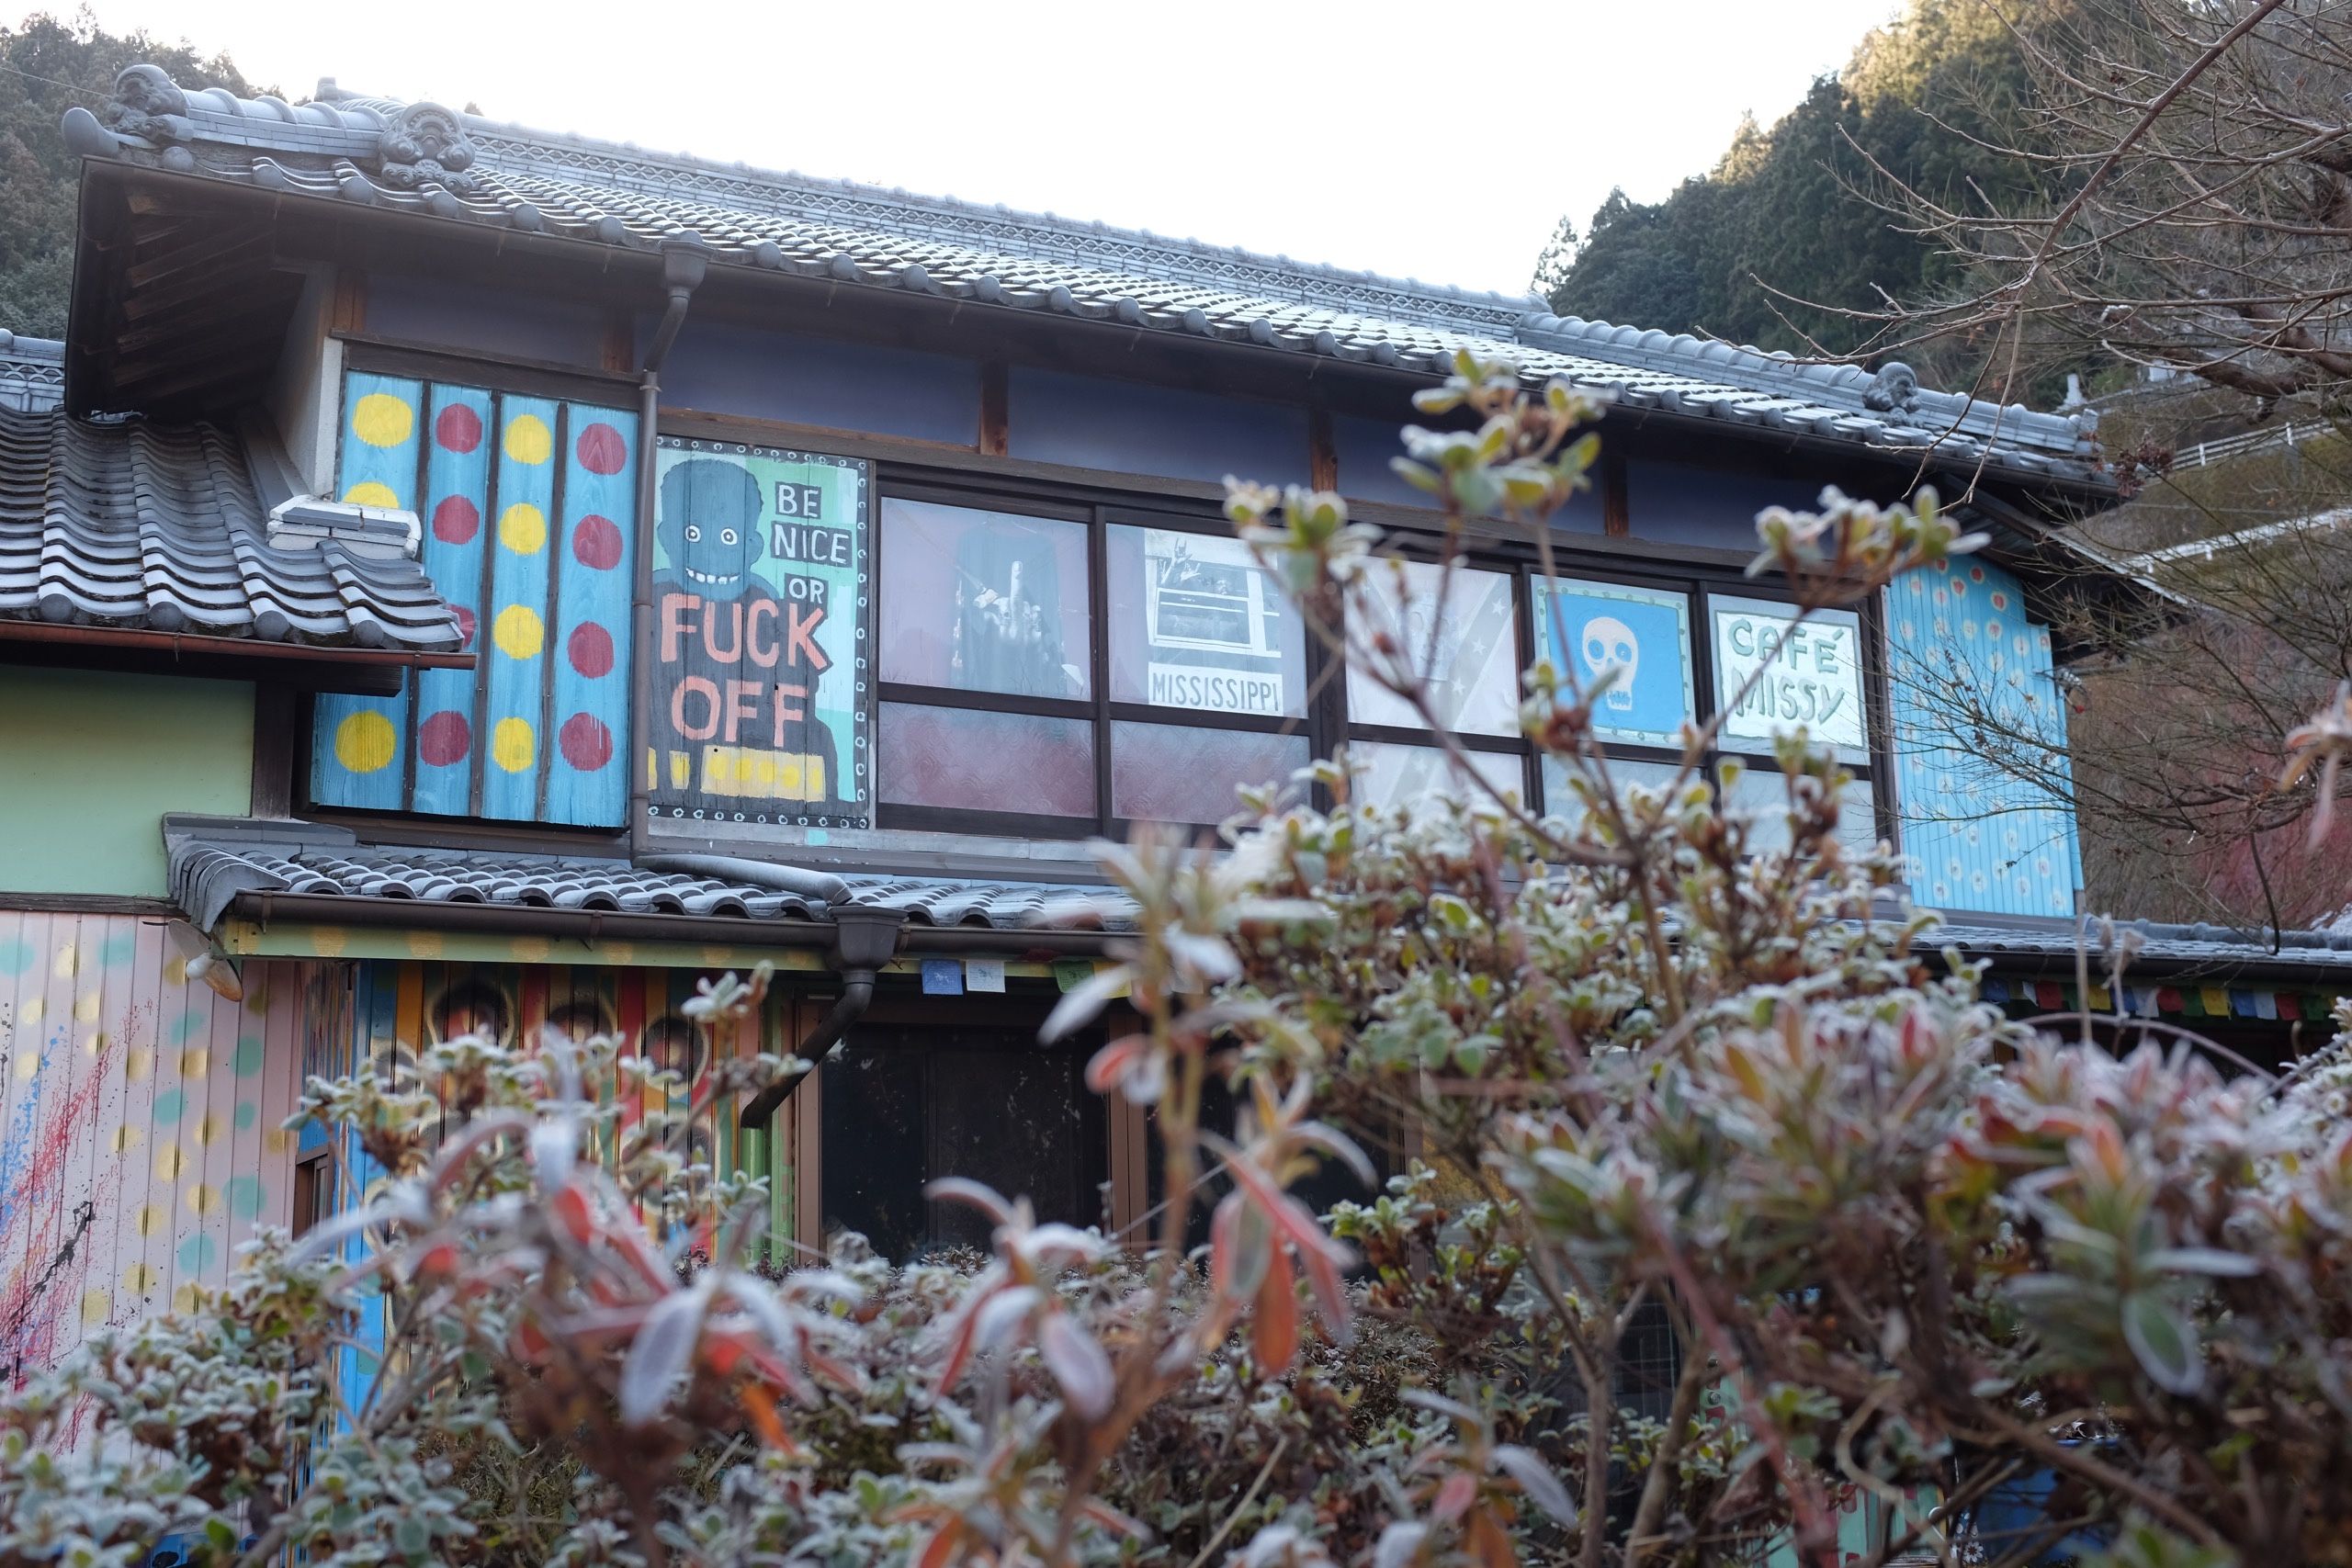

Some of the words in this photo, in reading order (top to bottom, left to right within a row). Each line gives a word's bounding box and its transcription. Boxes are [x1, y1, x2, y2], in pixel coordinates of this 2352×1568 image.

[778, 485, 820, 517] BE
[774, 524, 851, 564] NICE
[789, 578, 823, 604] OR
[661, 593, 828, 671] FUCK
[1729, 619, 1844, 674] CAFÉ
[672, 676, 808, 748] OFF
[1153, 672, 1279, 711] MISSISSIPPI
[1732, 667, 1845, 725] MISSY
